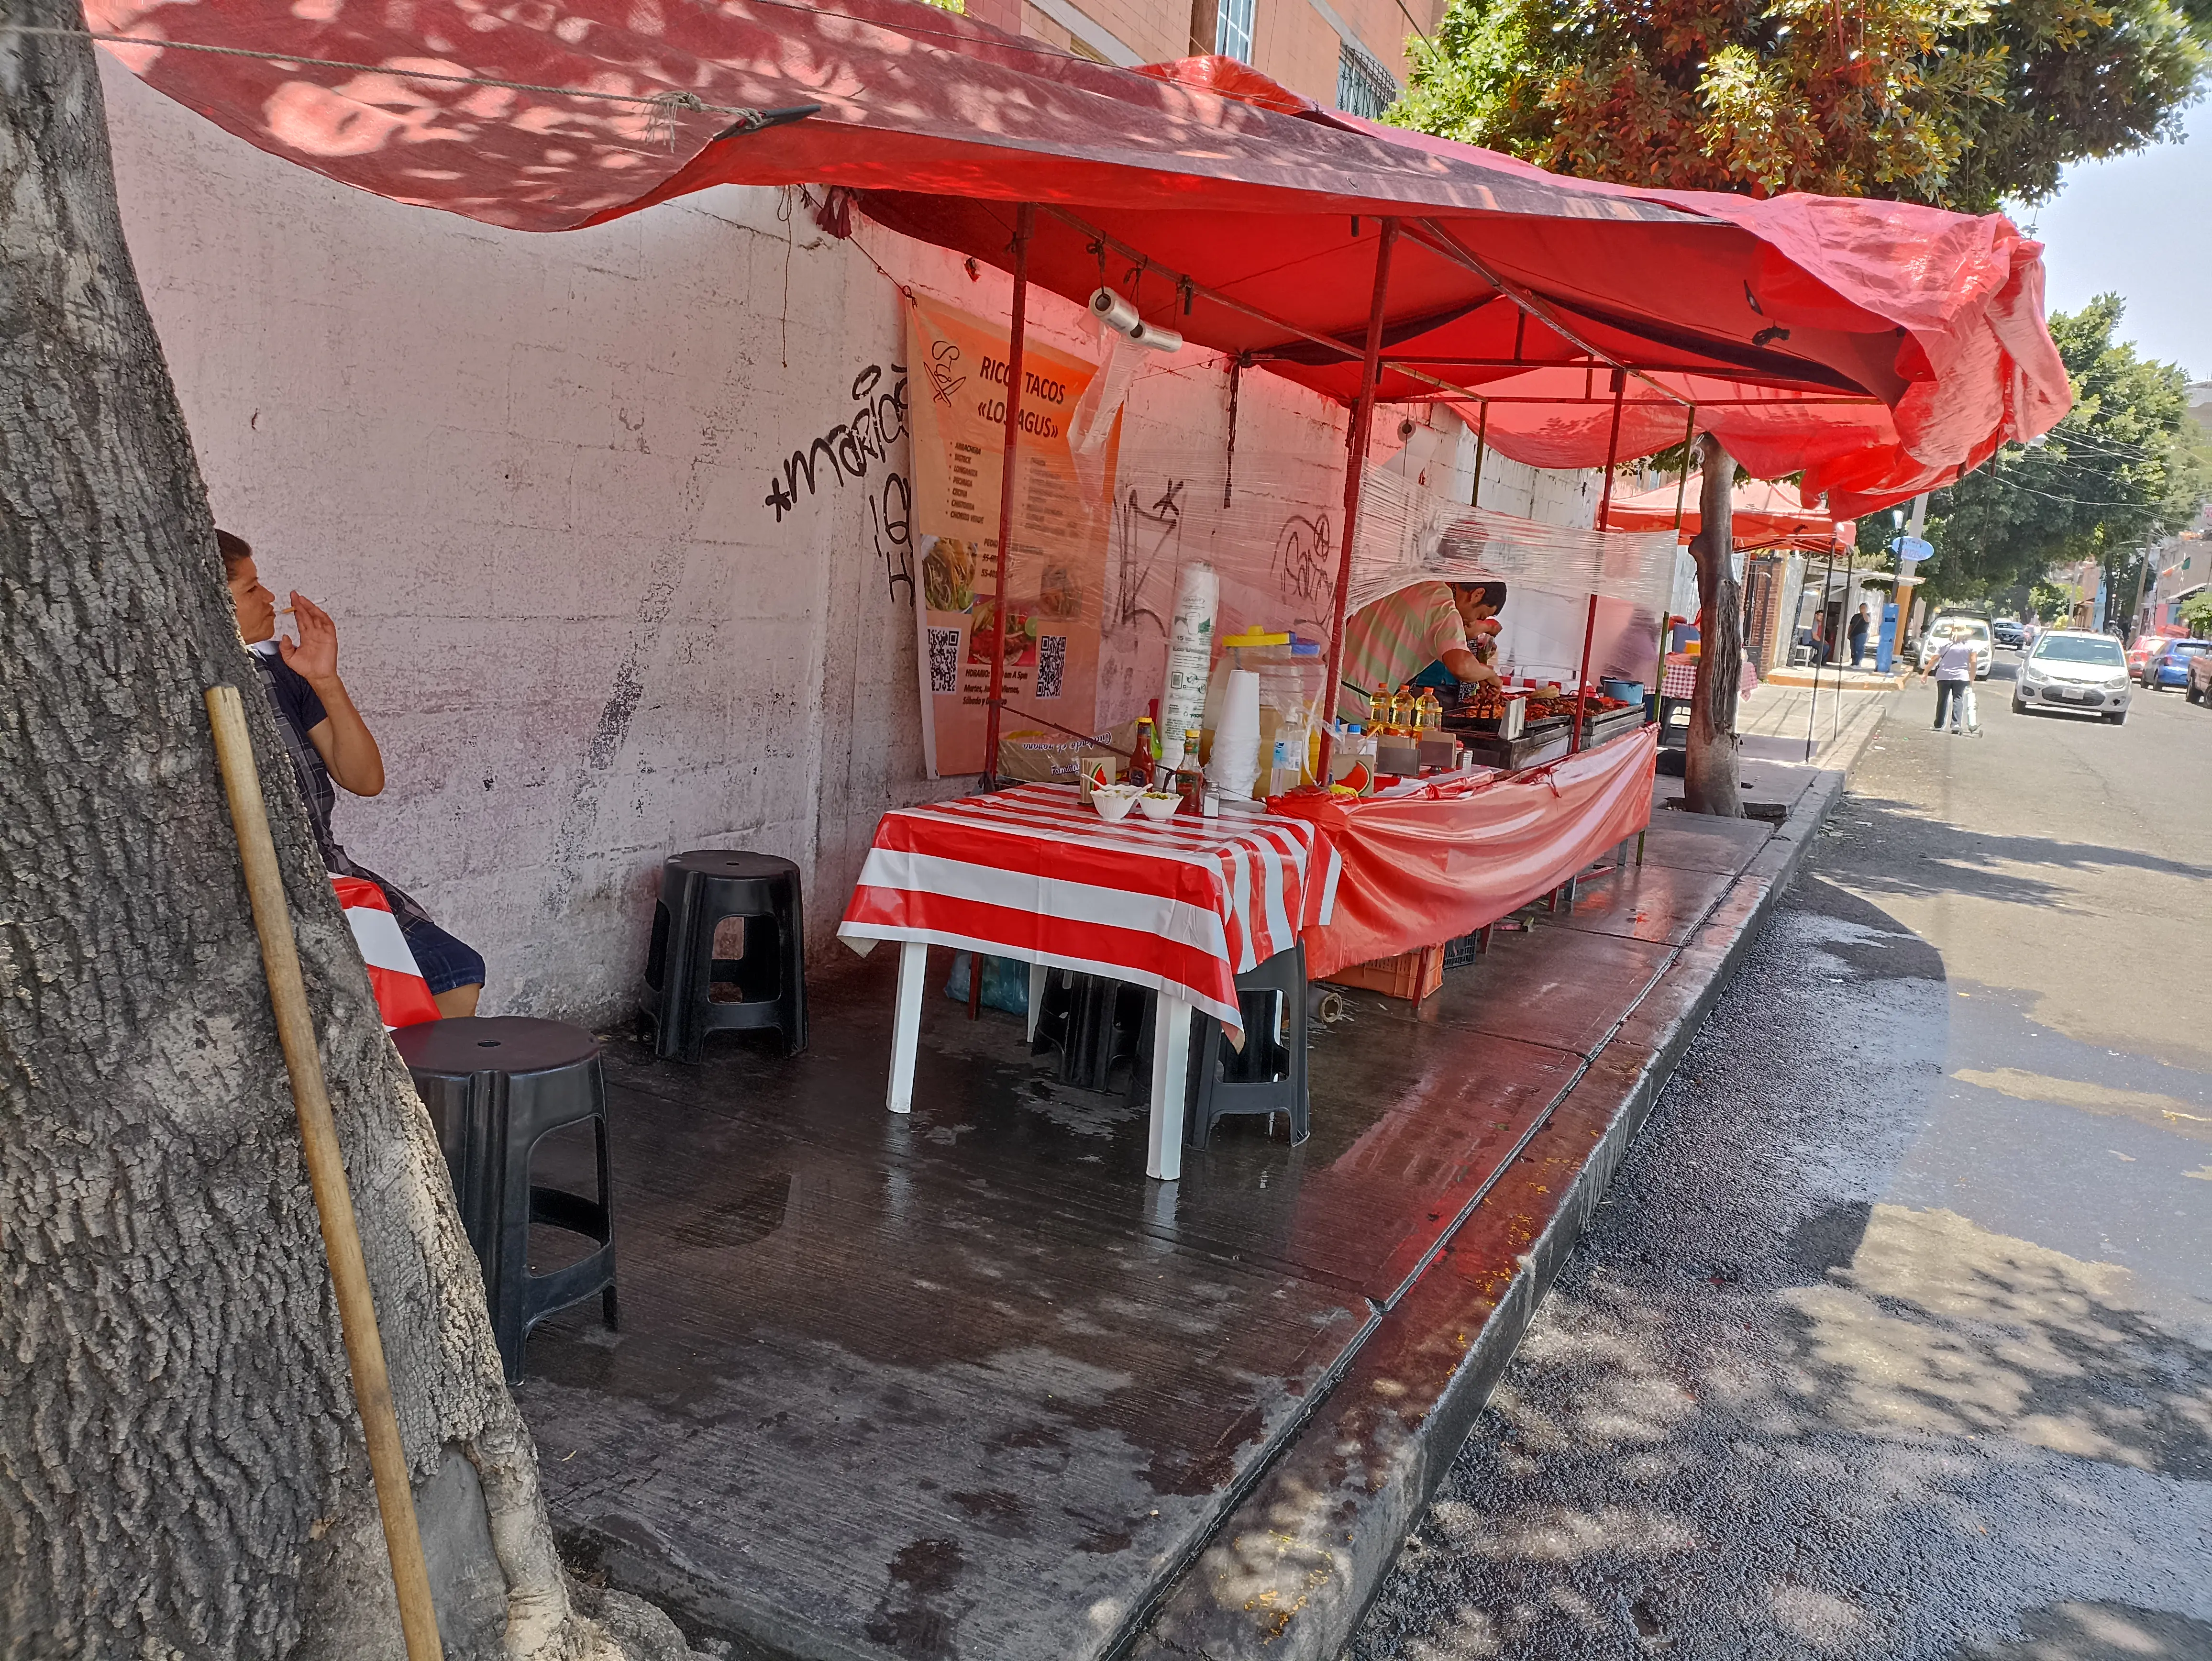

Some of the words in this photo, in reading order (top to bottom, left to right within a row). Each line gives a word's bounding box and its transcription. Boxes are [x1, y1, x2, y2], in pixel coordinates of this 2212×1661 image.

[980, 356, 1010, 387] RICO
[1026, 372, 1066, 405] TACOS
[1018, 409, 1058, 438] AGUS»
[965, 669, 990, 678] HORARIO:
[1017, 671, 1028, 680] 5pm
